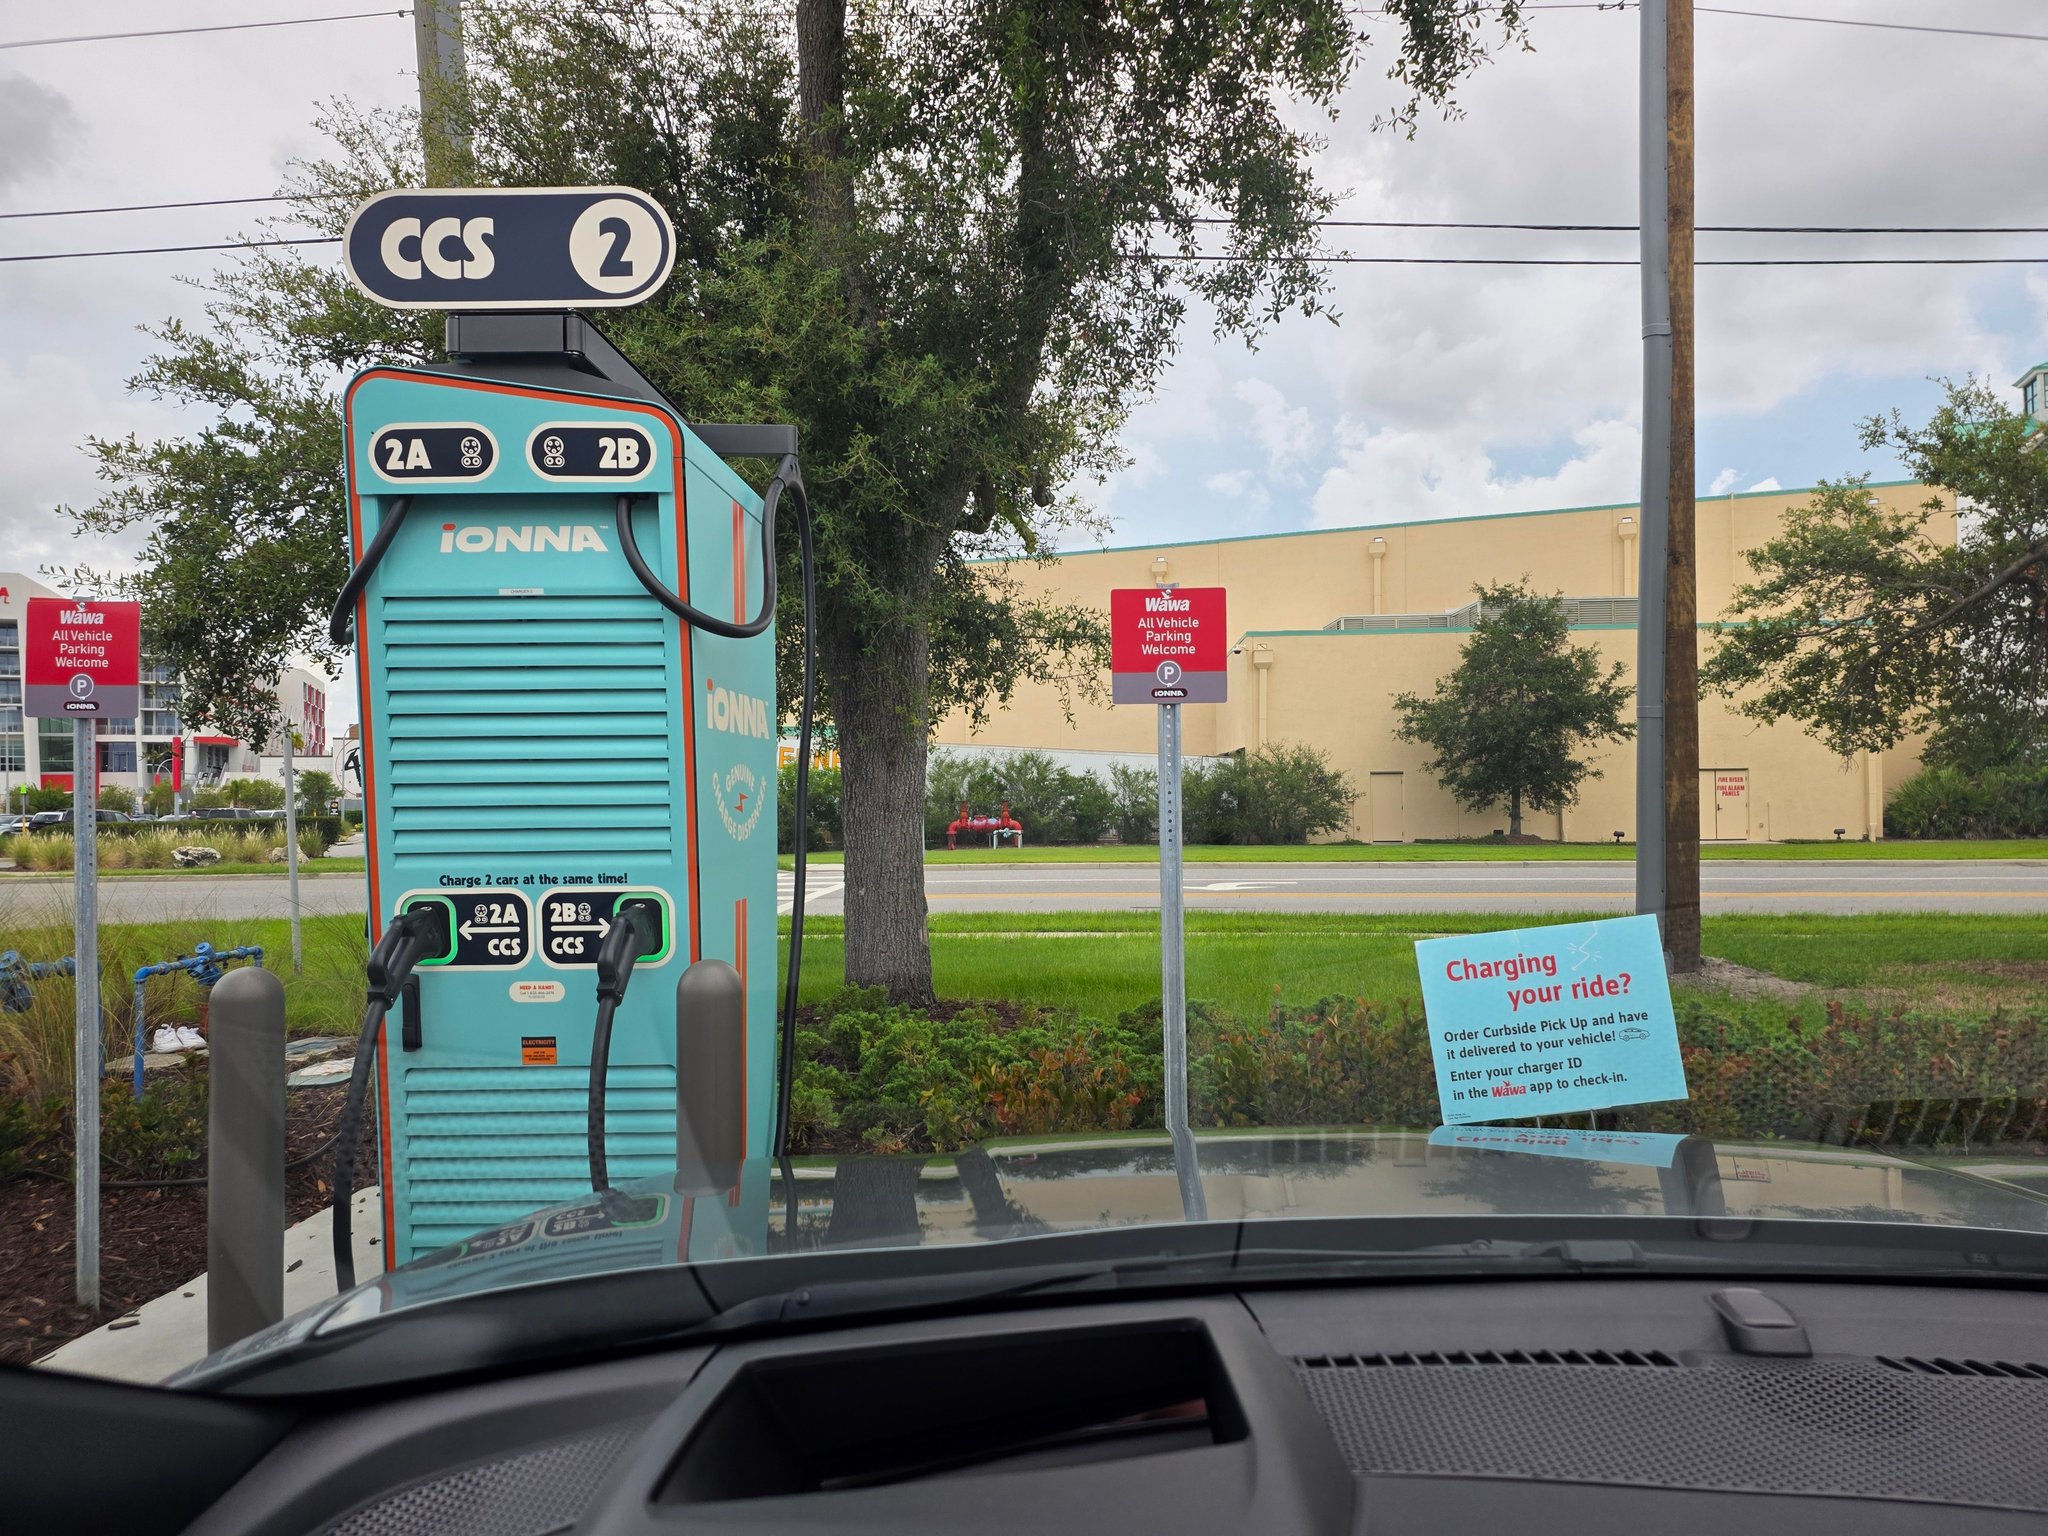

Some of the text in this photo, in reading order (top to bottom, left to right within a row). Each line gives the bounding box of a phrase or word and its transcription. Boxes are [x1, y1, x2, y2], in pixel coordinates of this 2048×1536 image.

[381, 217, 633, 279] CCS 2
[385, 438, 432, 470] 2A
[598, 437, 640, 469] 2B
[1145, 597, 1191, 612] Wawa
[60, 610, 105, 625] Wawa
[1138, 617, 1199, 629] All Vehicle
[52, 630, 113, 641] All Vehicle
[1146, 631, 1192, 644] Parking
[60, 643, 105, 657] Parking
[1142, 644, 1196, 655] Welcome
[55, 656, 109, 668] Welcome
[1164, 666, 1175, 680] P
[77, 680, 87, 693] P
[725, 763, 755, 793] GENUINE
[712, 772, 737, 839] CHARGE
[439, 873, 628, 888] Charge 2 cars at the same time!
[490, 904, 520, 924] 2A
[550, 903, 577, 923] 2B
[488, 938, 521, 956] CCS
[551, 937, 584, 954] CCS
[1446, 953, 1557, 982] Charging
[1507, 972, 1632, 1012] your ride?
[1444, 1011, 1649, 1042] Order Curbside Pick Up and have
[1446, 1030, 1616, 1060] it delivered to your vehicle!
[1450, 1057, 1582, 1081] Enter your charger ID
[1453, 1072, 1627, 1100] in the Wawa app to check-in.
